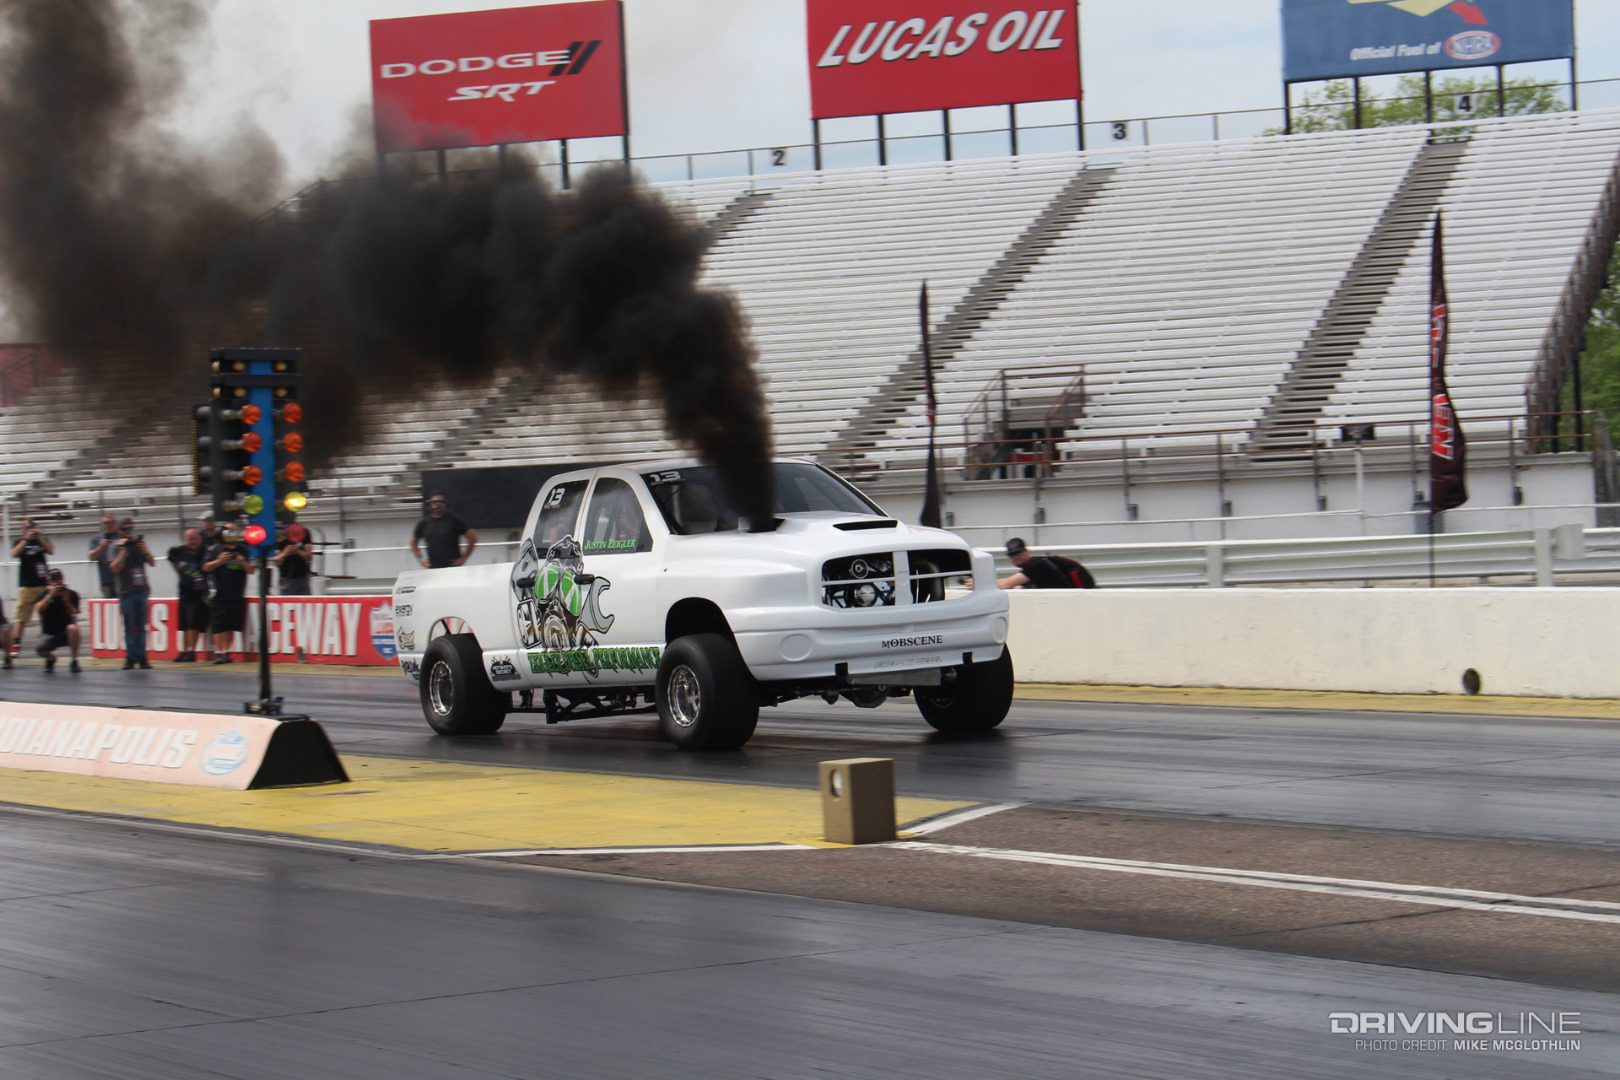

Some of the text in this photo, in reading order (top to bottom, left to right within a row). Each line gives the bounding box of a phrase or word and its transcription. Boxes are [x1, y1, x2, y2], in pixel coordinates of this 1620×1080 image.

[816, 9, 1066, 68] LUCAS OIL
[1350, 45, 1396, 60] Official
[1397, 43, 1426, 57] Fuel
[1426, 41, 1443, 55] of
[380, 50, 572, 79] DODGE
[447, 80, 557, 102] SRT
[1458, 95, 1471, 112] 4
[1114, 123, 1126, 140] 3
[772, 149, 786, 166] 2
[650, 471, 681, 482] 13
[548, 488, 566, 506] 13
[608, 538, 637, 549] ZEIGLER
[881, 634, 943, 649] MOBSCENE
